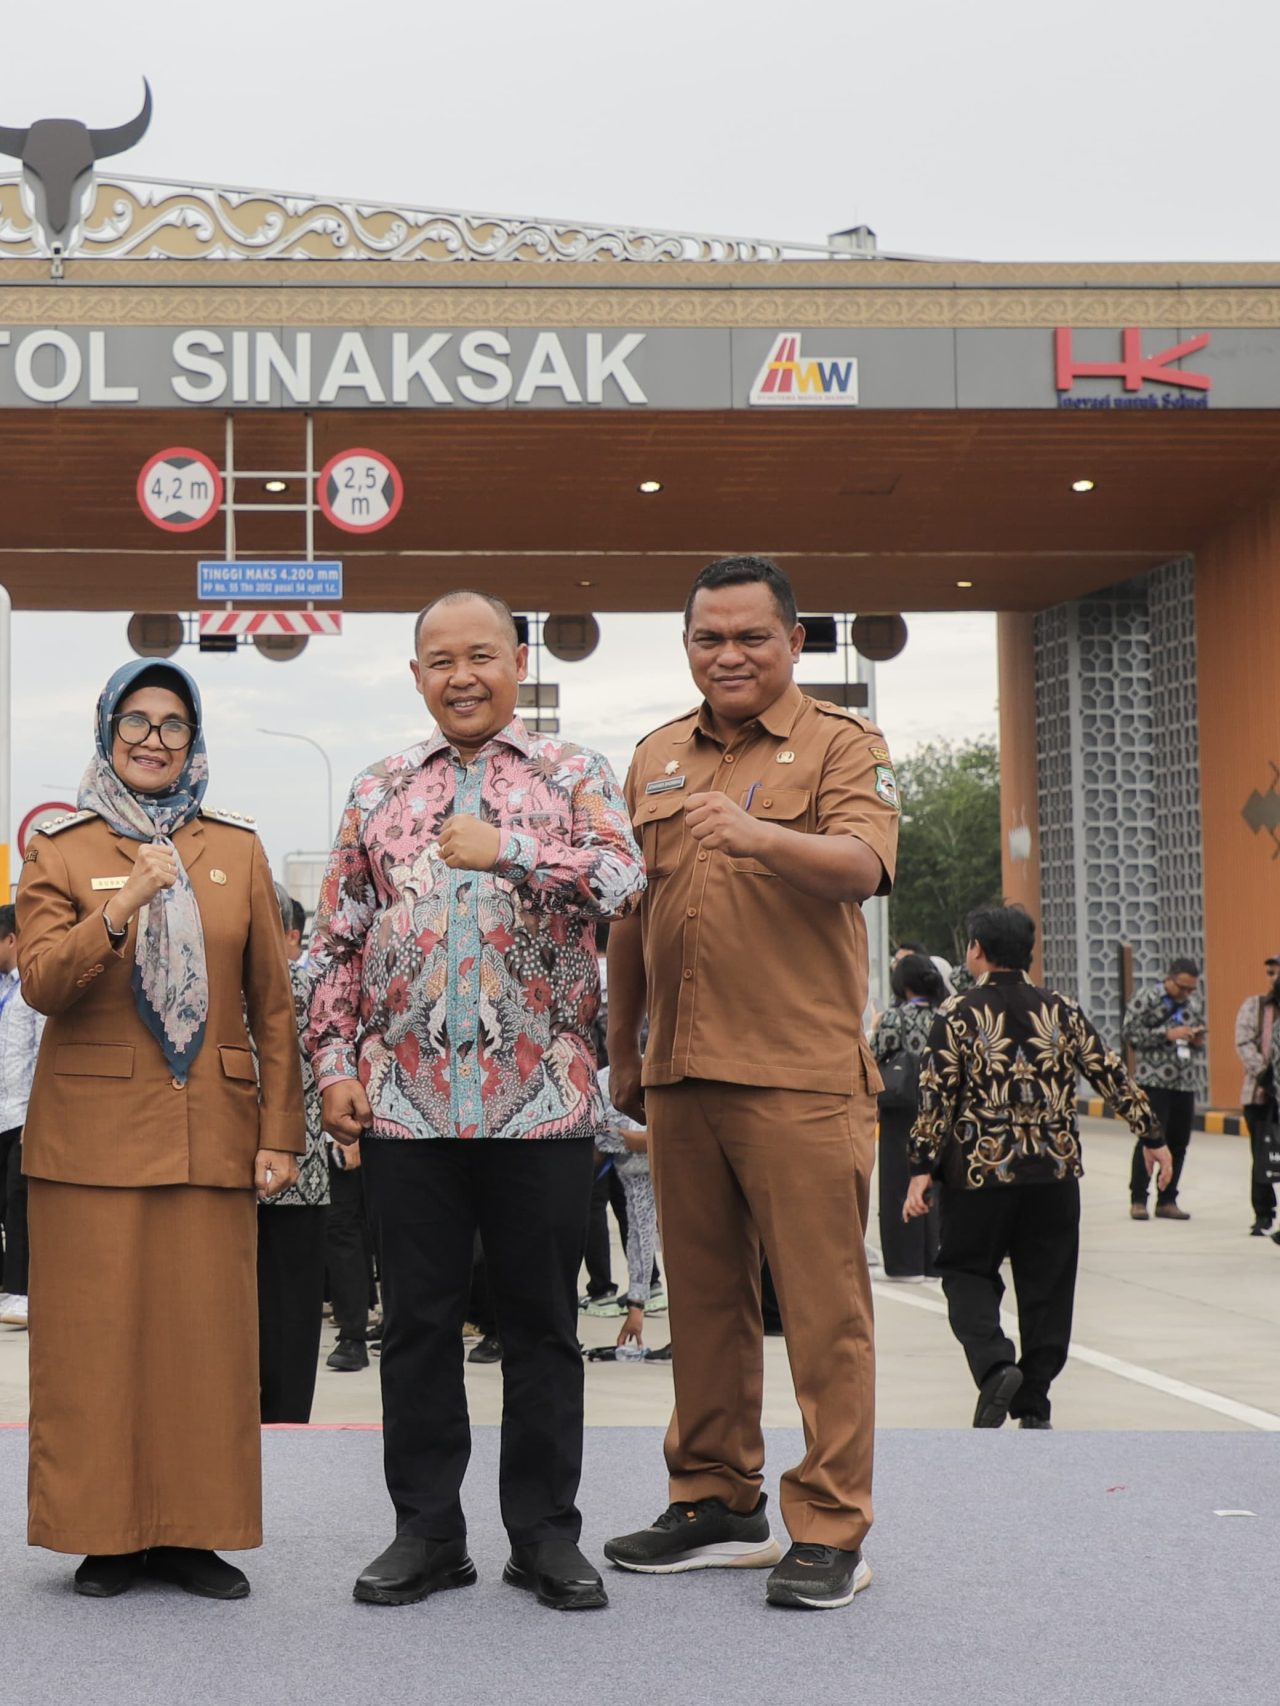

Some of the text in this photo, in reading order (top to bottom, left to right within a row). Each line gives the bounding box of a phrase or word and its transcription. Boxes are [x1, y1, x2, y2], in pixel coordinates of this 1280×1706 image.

[170, 330, 648, 404] SINAKSAK
[1055, 327, 1212, 391] HK
[151, 477, 208, 503] 4,2 m
[344, 467, 376, 492] 2,5
[352, 498, 369, 515] m
[202, 568, 338, 581] TINGGI MAKS 4.200 mm
